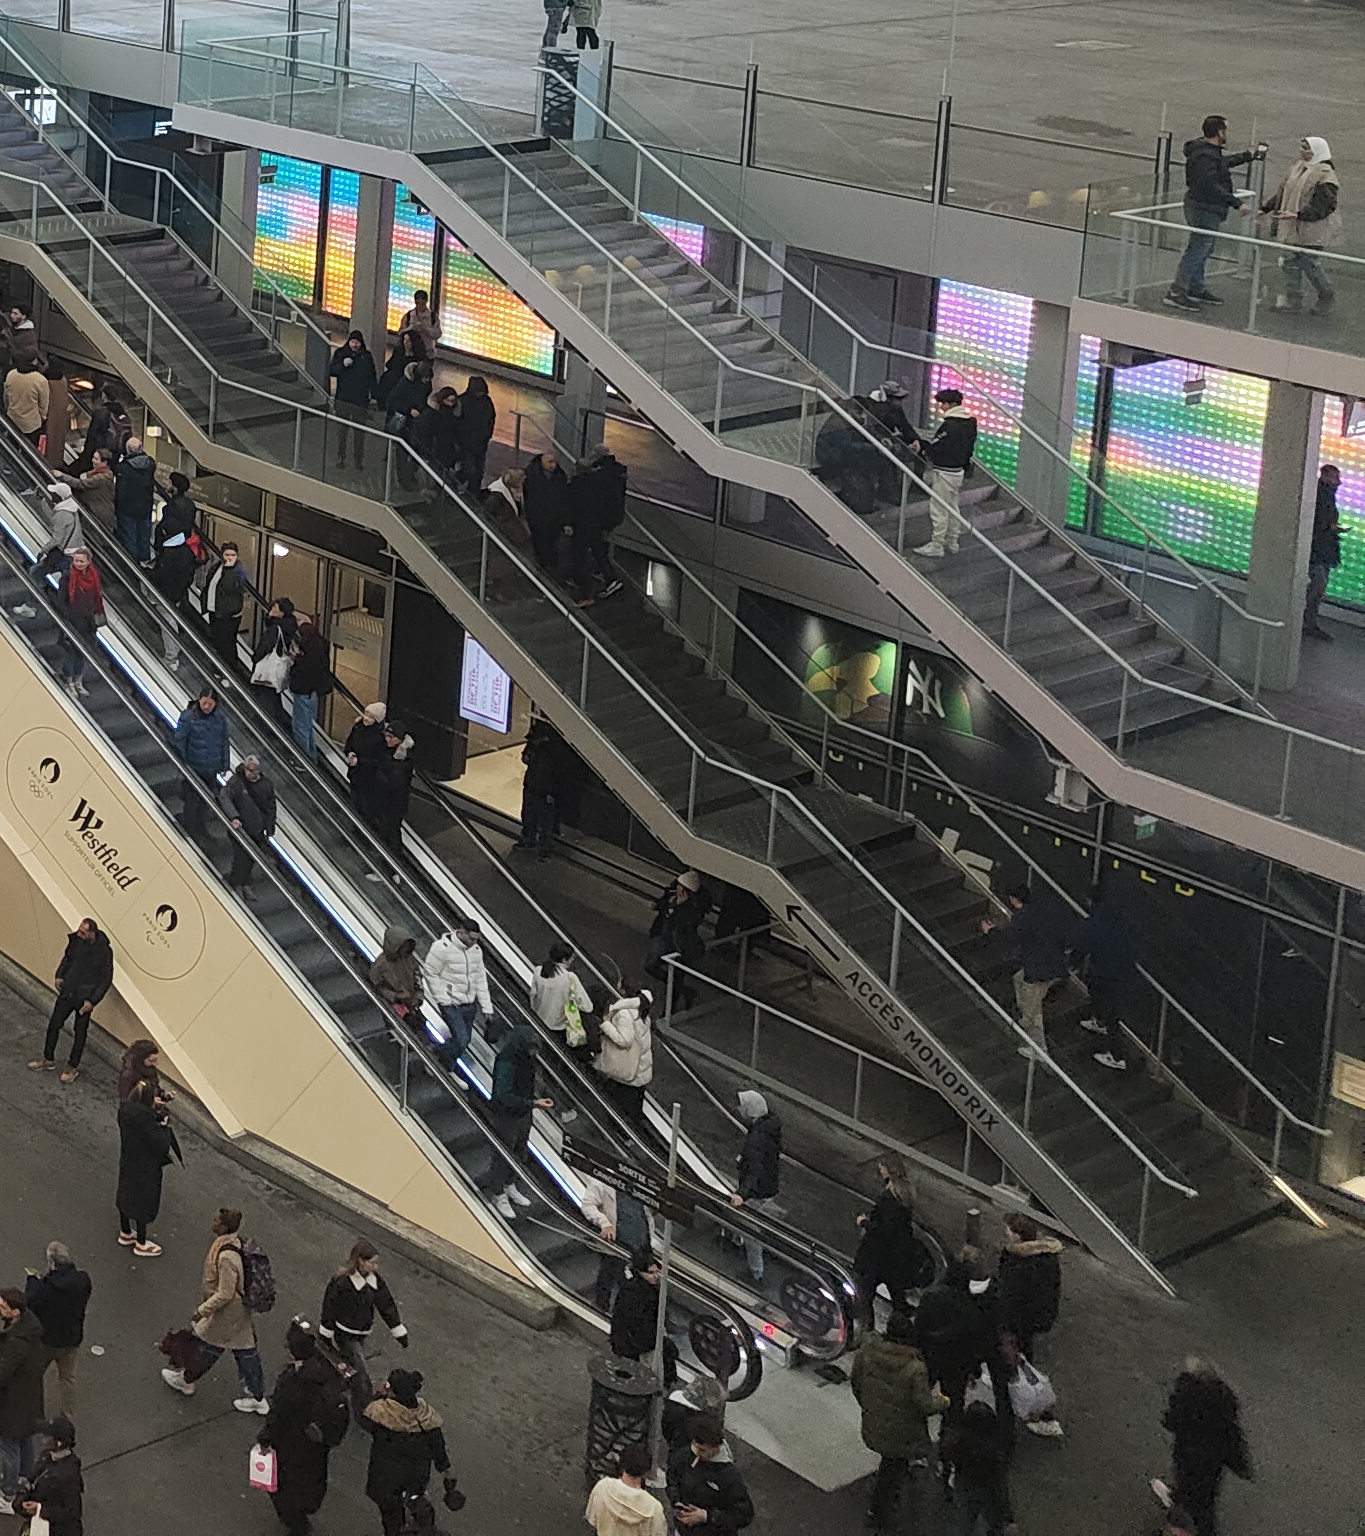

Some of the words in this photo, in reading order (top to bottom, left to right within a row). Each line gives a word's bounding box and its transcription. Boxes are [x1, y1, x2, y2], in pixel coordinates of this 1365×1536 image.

[63, 830, 95, 872] SUPPORTEUR
[93, 868, 116, 897] OFFICIEL
[68, 796, 141, 892] Westfield
[845, 971, 905, 1032] ACCÈS
[903, 1029, 1001, 1133] MONOPRIX
